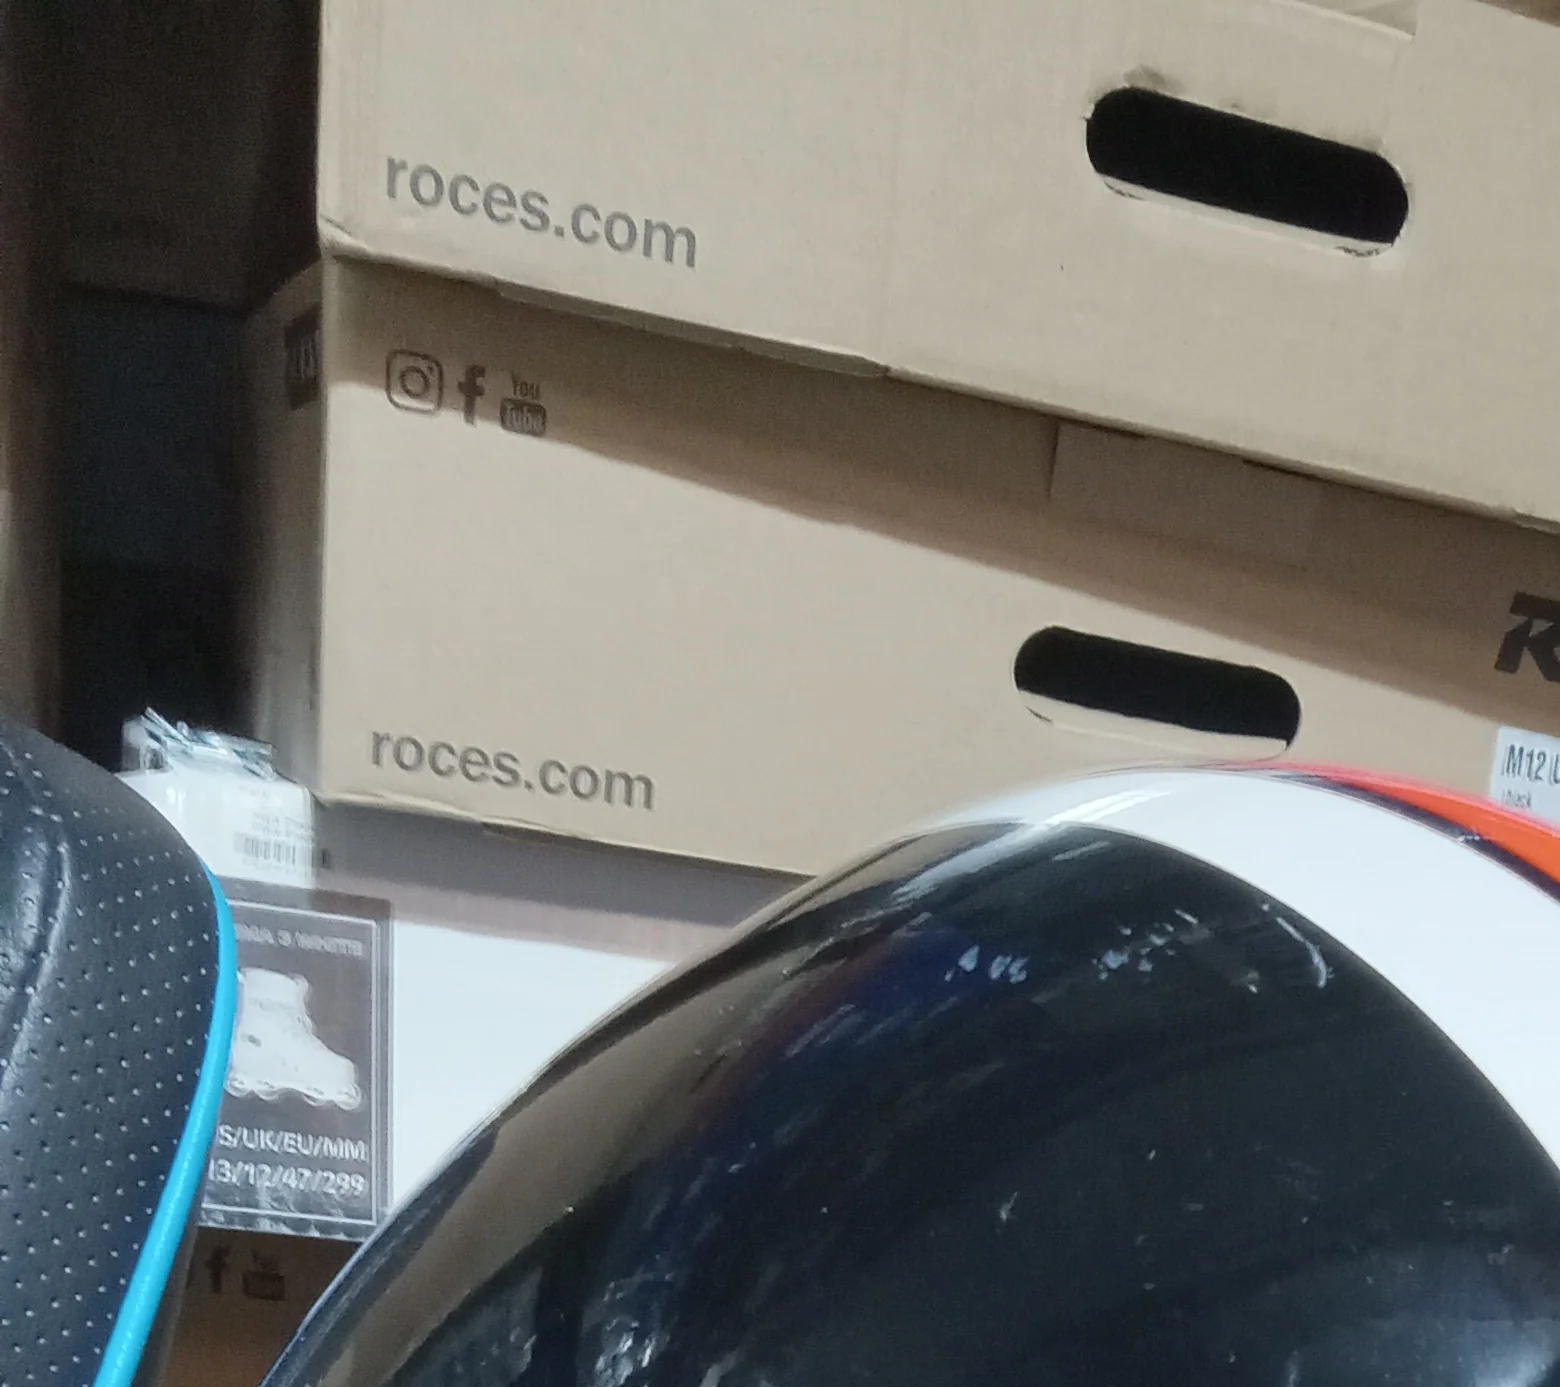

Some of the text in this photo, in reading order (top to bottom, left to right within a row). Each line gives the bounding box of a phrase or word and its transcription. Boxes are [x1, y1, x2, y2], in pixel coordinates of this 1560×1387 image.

[387, 156, 696, 268] roces.com
[371, 730, 655, 810] roces.com
[1503, 744, 1546, 781] M12
